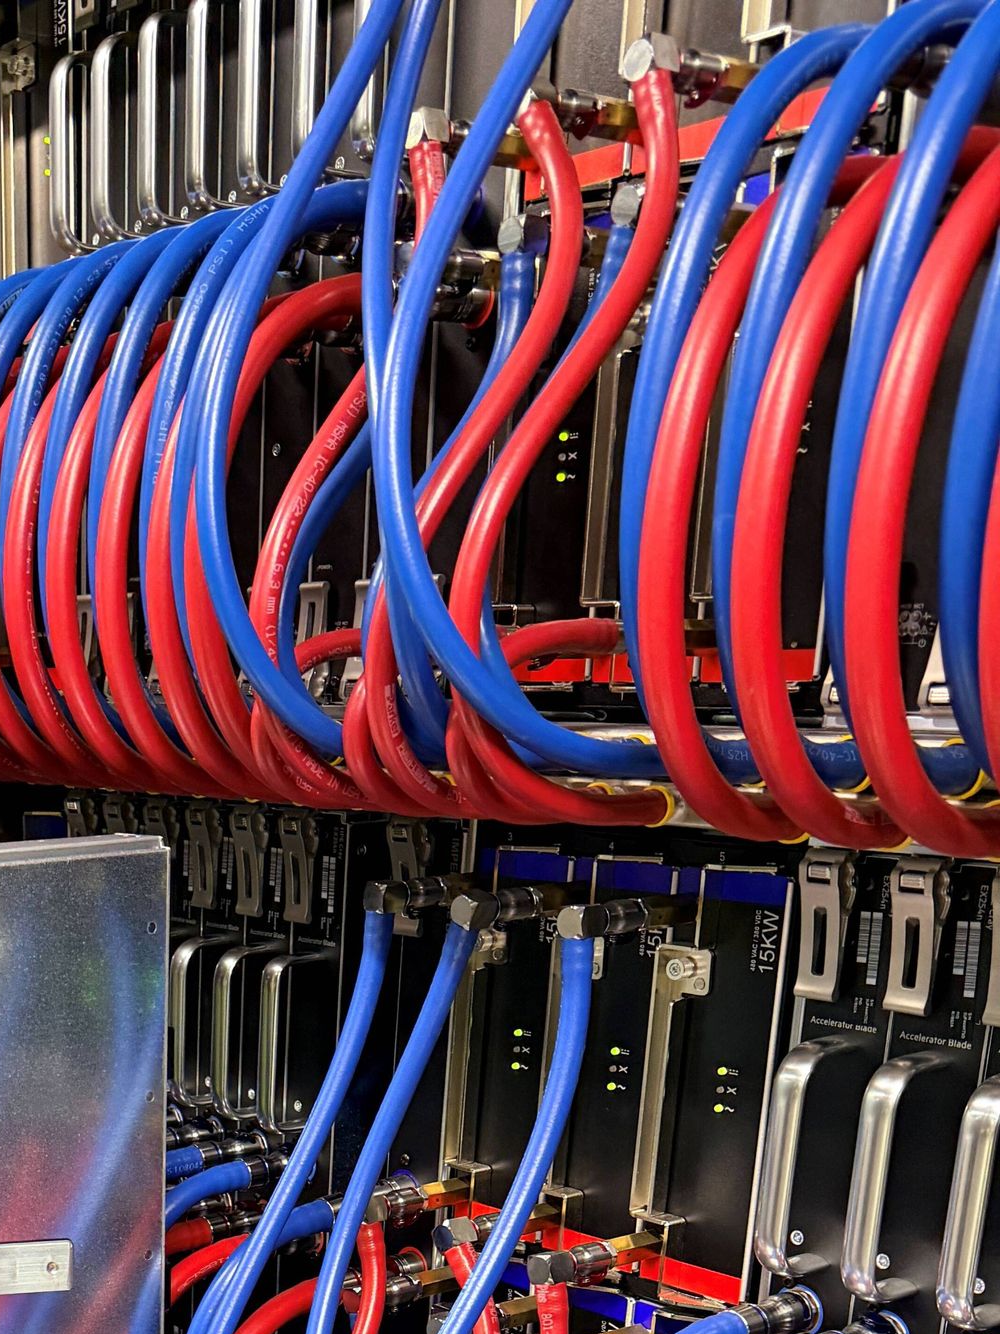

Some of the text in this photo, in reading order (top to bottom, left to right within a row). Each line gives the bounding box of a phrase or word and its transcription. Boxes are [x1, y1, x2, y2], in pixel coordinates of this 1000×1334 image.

[608, 841, 614, 850] 4
[719, 851, 726, 862] 5
[976, 884, 989, 920] EX254n
[758, 910, 780, 974] 15KW
[810, 1015, 853, 1030] Accelerator
[899, 1030, 973, 1050] Accelerator Blade
